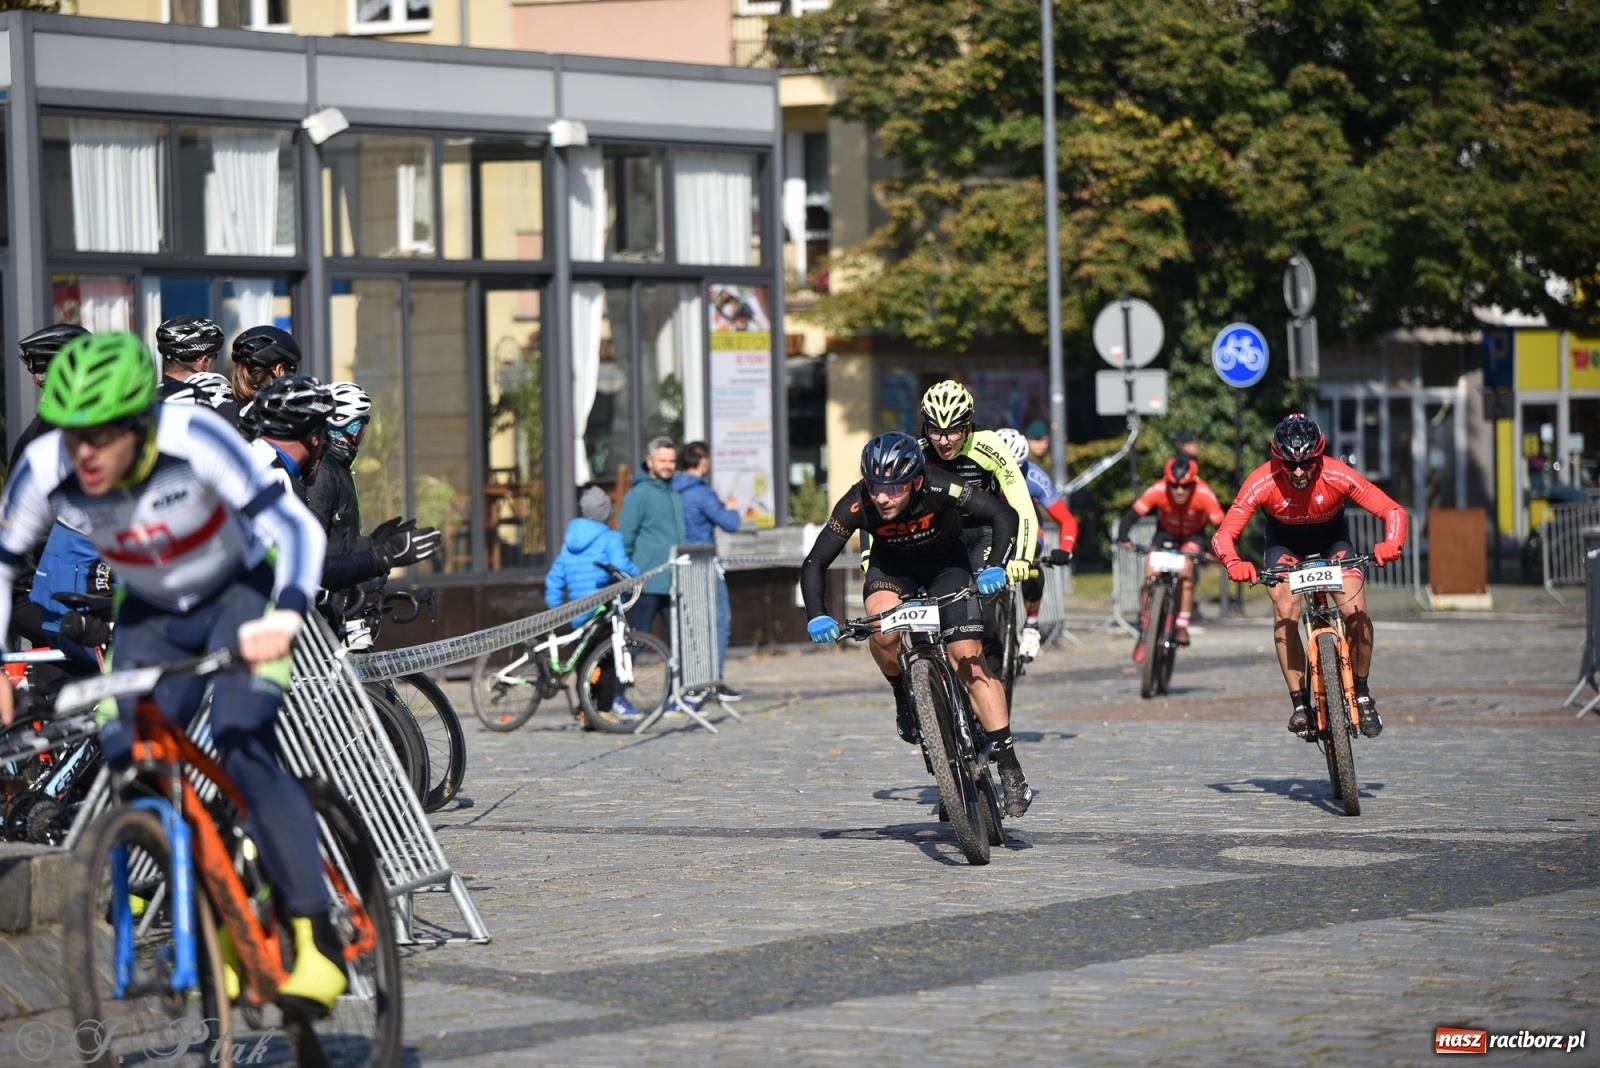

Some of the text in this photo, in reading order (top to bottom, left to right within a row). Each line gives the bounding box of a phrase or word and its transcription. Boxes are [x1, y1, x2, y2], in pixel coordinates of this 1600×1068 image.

[976, 441, 1007, 467] HEAD
[1299, 570, 1333, 584] 1628
[890, 610, 928, 624] 1407
